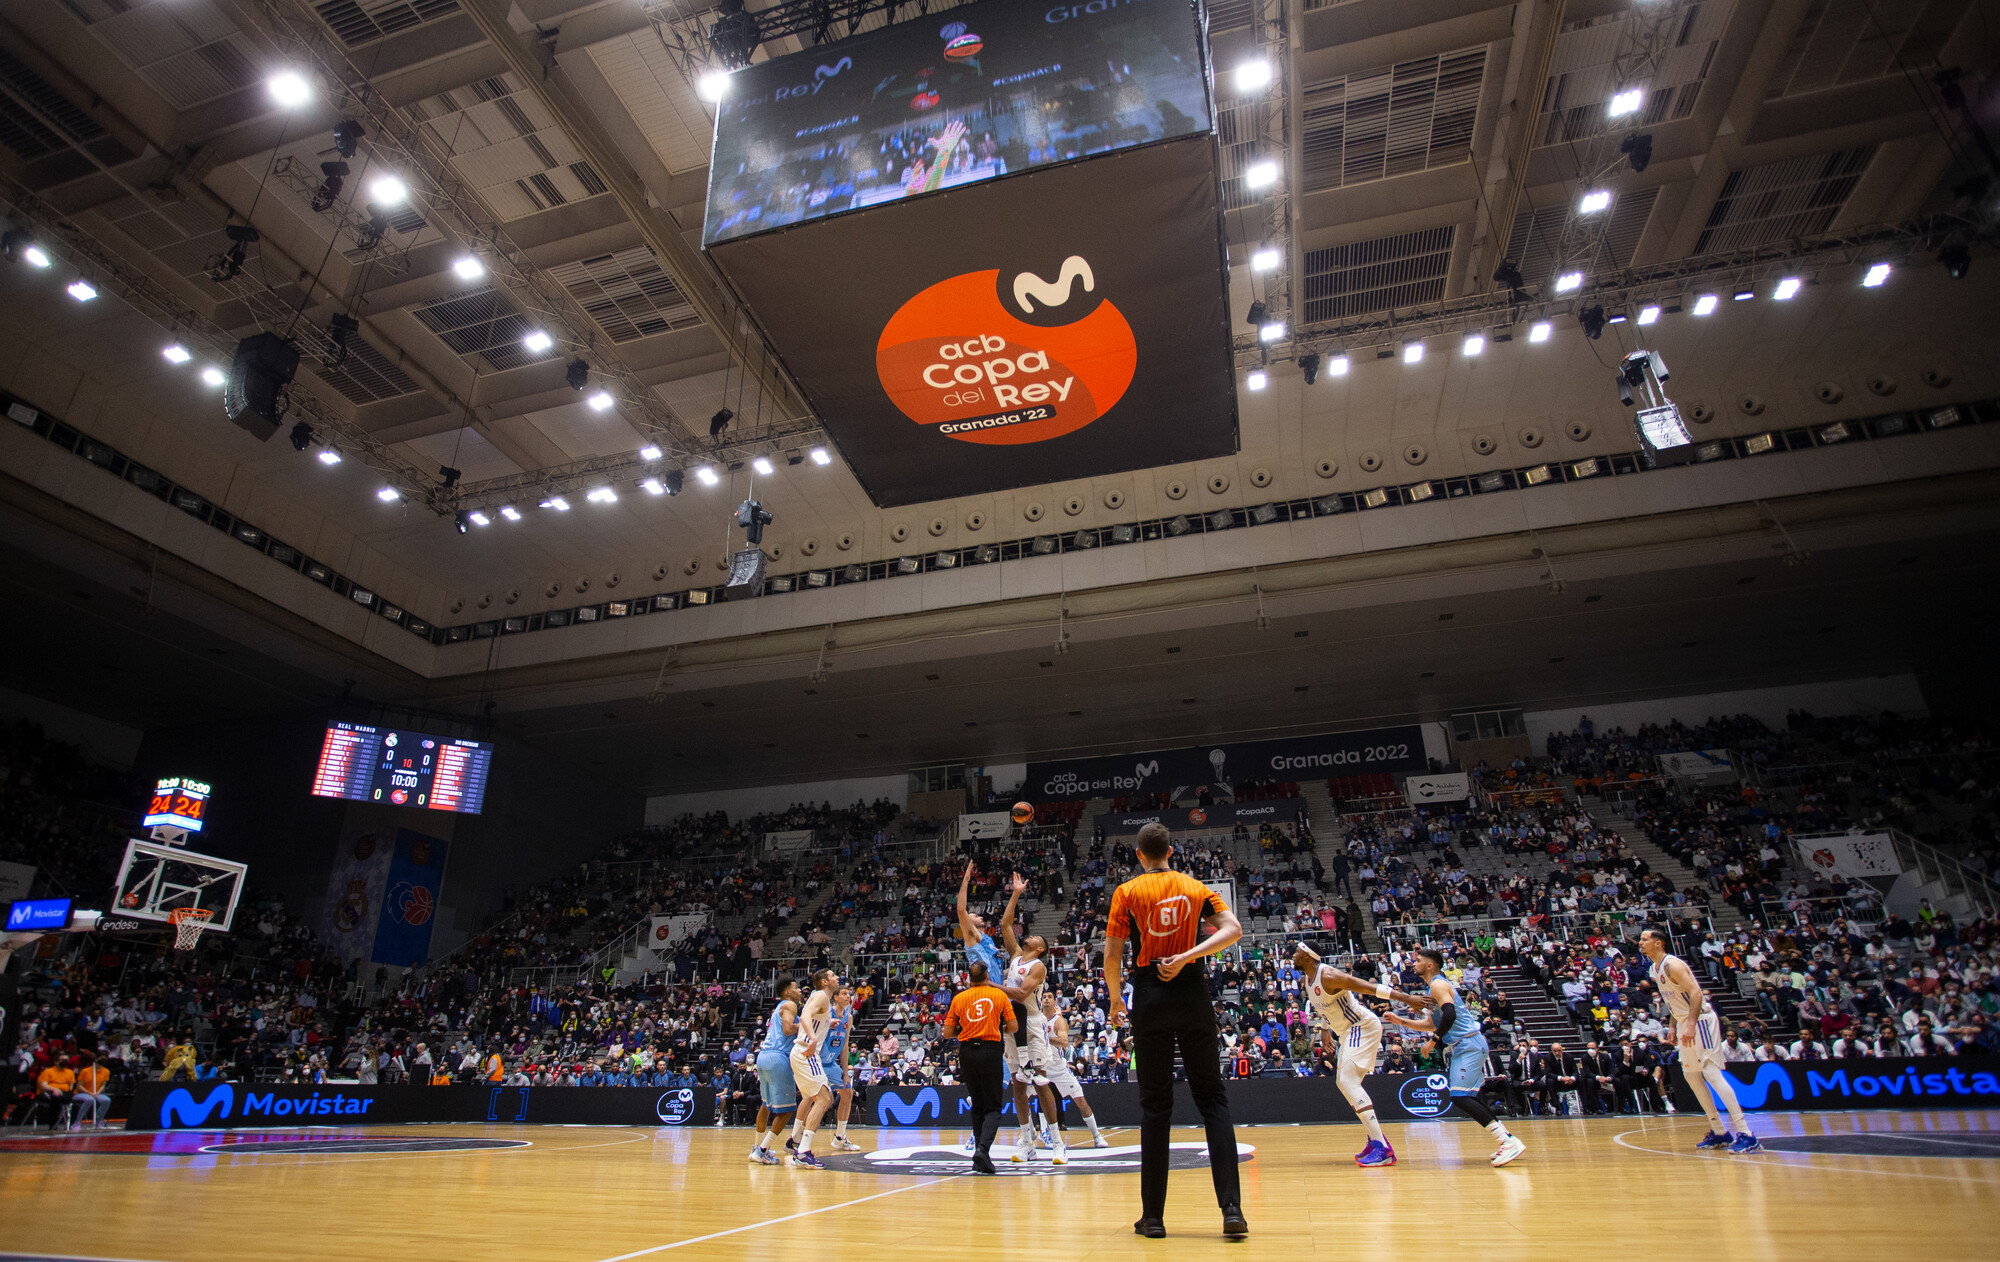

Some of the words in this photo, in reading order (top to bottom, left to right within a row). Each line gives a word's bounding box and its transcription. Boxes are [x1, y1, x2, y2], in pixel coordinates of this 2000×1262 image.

[939, 334, 1006, 361] acb
[922, 350, 1050, 389] Copa
[943, 387, 985, 407] del
[992, 376, 1074, 408] Rey
[939, 413, 1021, 435] Granada
[337, 722, 352, 730] REAL
[354, 725, 376, 733] MADRID
[386, 749, 394, 761] 0
[422, 754, 431, 766] 0
[1271, 749, 1361, 771] Granada
[1364, 744, 1410, 762] 2022
[391, 774, 418, 788] 10:00
[1053, 771, 1077, 783] acb
[182, 778, 210, 795] 10:00
[1044, 780, 1090, 796] Copa
[1091, 778, 1111, 790] del
[1113, 776, 1144, 791] Rey
[373, 788, 382, 800] 0
[417, 793, 426, 805] 0
[148, 795, 171, 815] 24
[173, 796, 202, 819] 24
[1236, 807, 1275, 816] #CopaACB
[1122, 817, 1160, 826] #CopaACB
[33, 907, 65, 918] Movistar
[1160, 907, 1178, 926] 61
[102, 919, 139, 932] endesa
[975, 1004, 983, 1017] 5
[1806, 1066, 2000, 1097] Movista
[1411, 1091, 1438, 1099] Copa
[242, 1092, 373, 1116] Movistar
